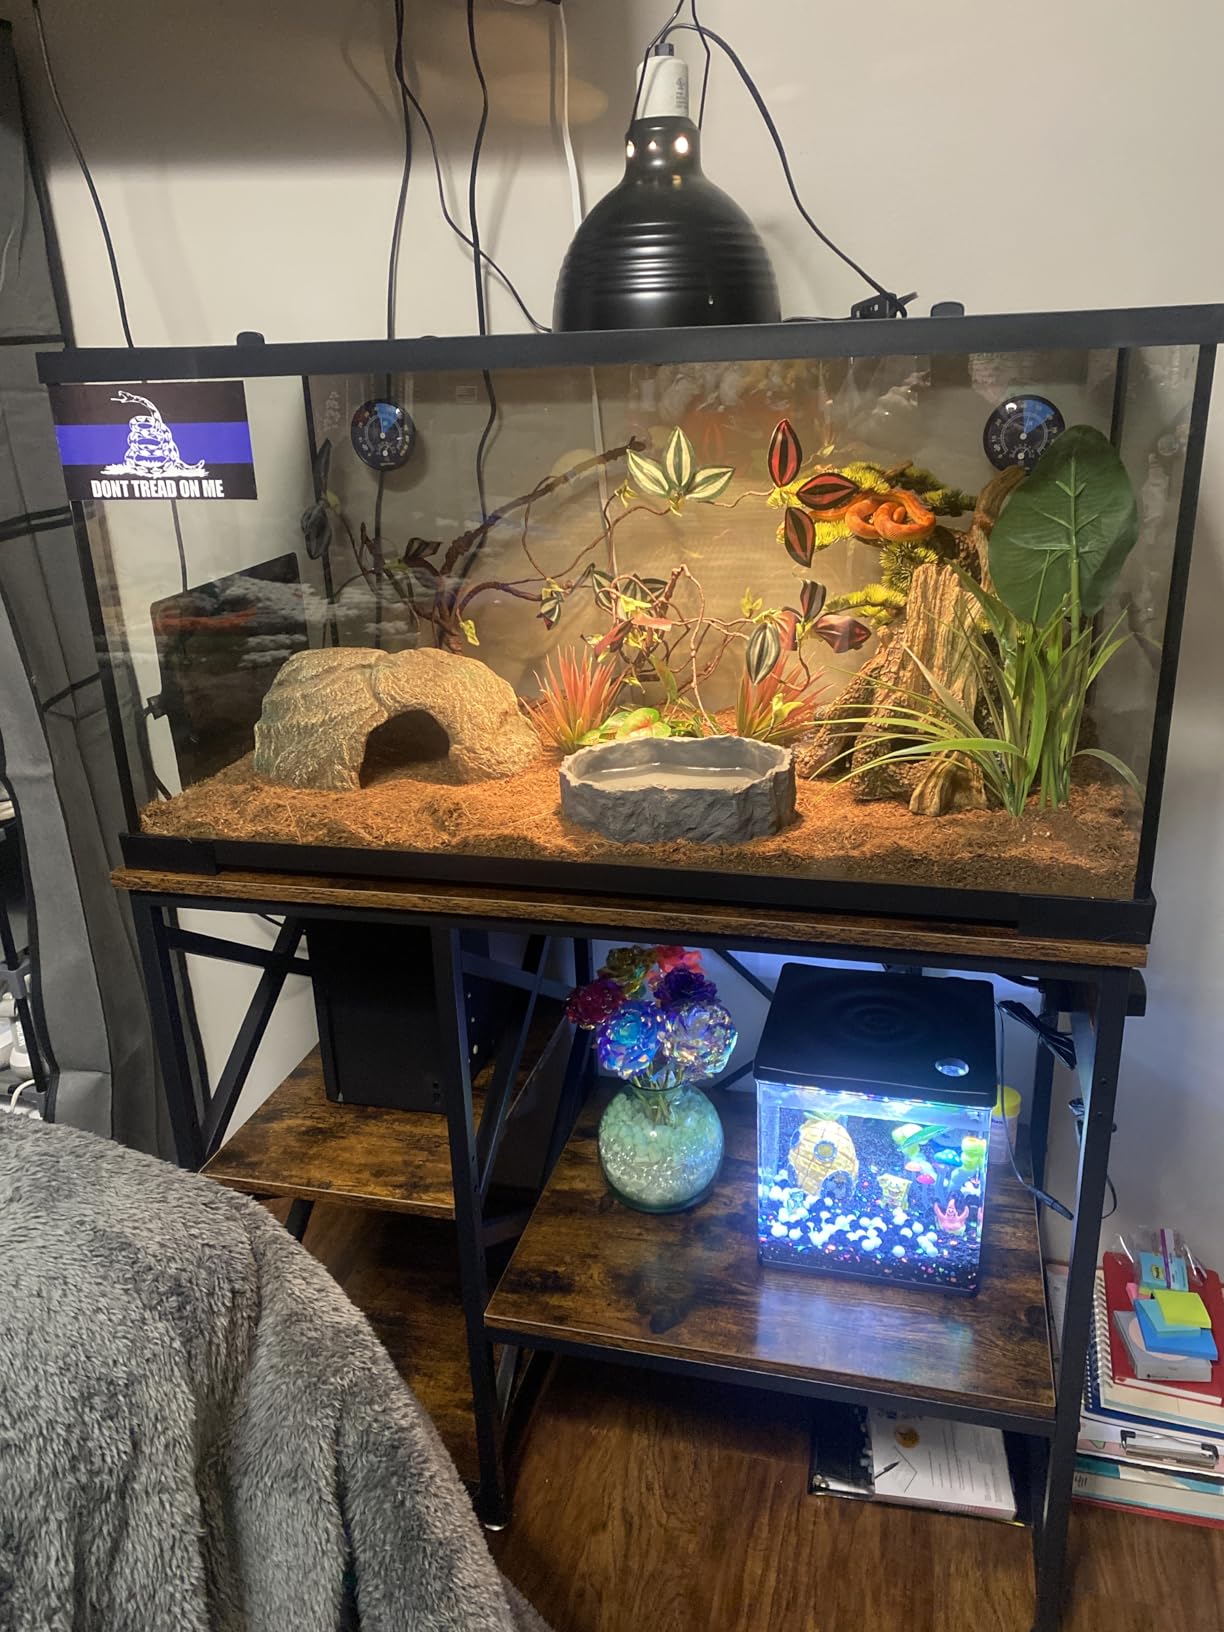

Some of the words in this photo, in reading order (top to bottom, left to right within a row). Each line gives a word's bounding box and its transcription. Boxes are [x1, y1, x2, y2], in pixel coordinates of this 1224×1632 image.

[90, 480, 129, 498] DONT
[131, 480, 178, 498] TREAD
[179, 480, 201, 498] ON
[202, 480, 225, 498] ME
